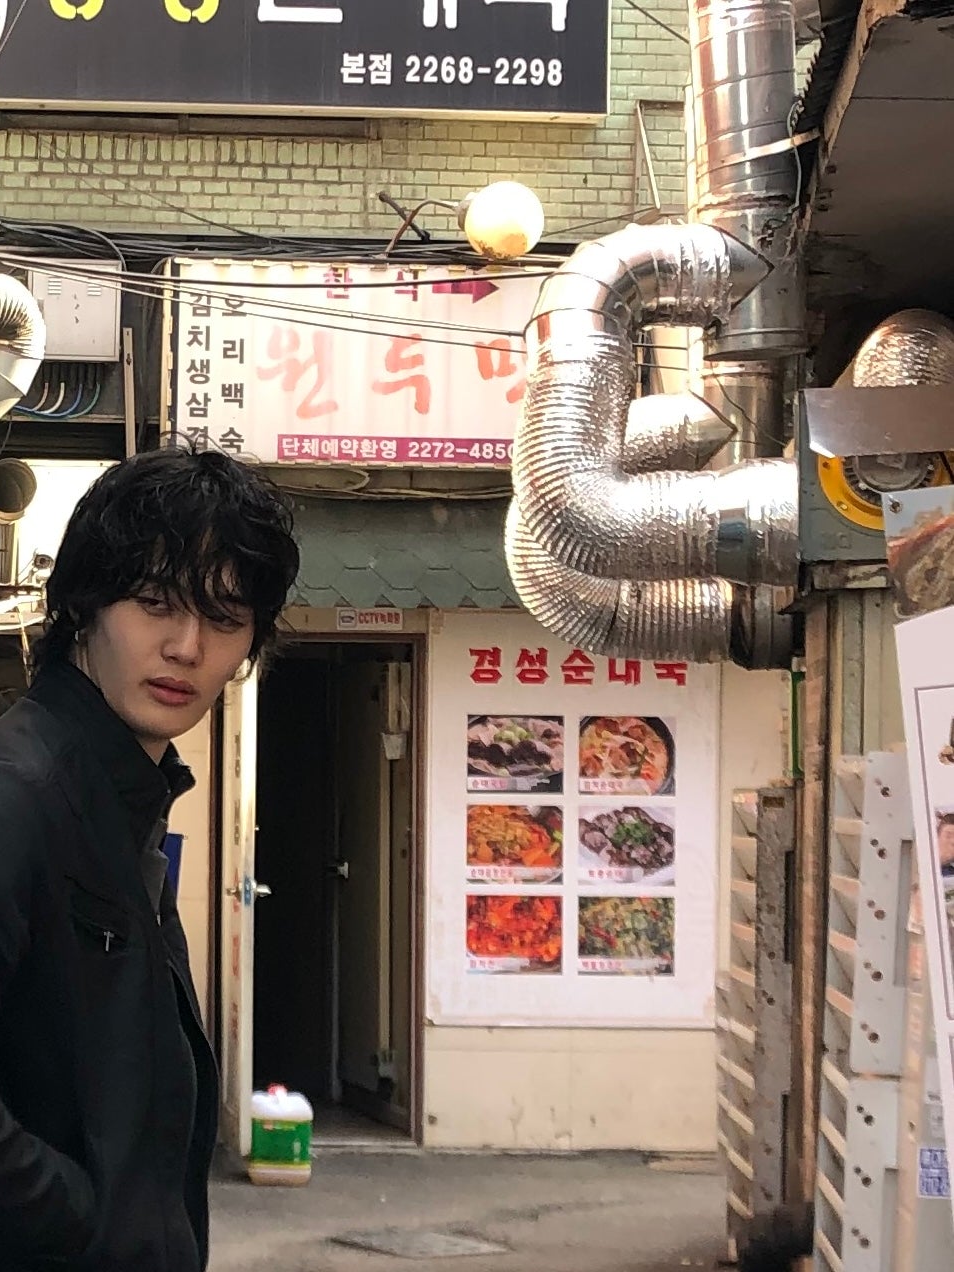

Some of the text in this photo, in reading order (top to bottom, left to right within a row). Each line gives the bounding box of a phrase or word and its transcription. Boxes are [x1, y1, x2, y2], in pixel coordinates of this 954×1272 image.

[340, 52, 563, 86] 본점 2268-2298
[281, 437, 397, 459] 단체예약환영
